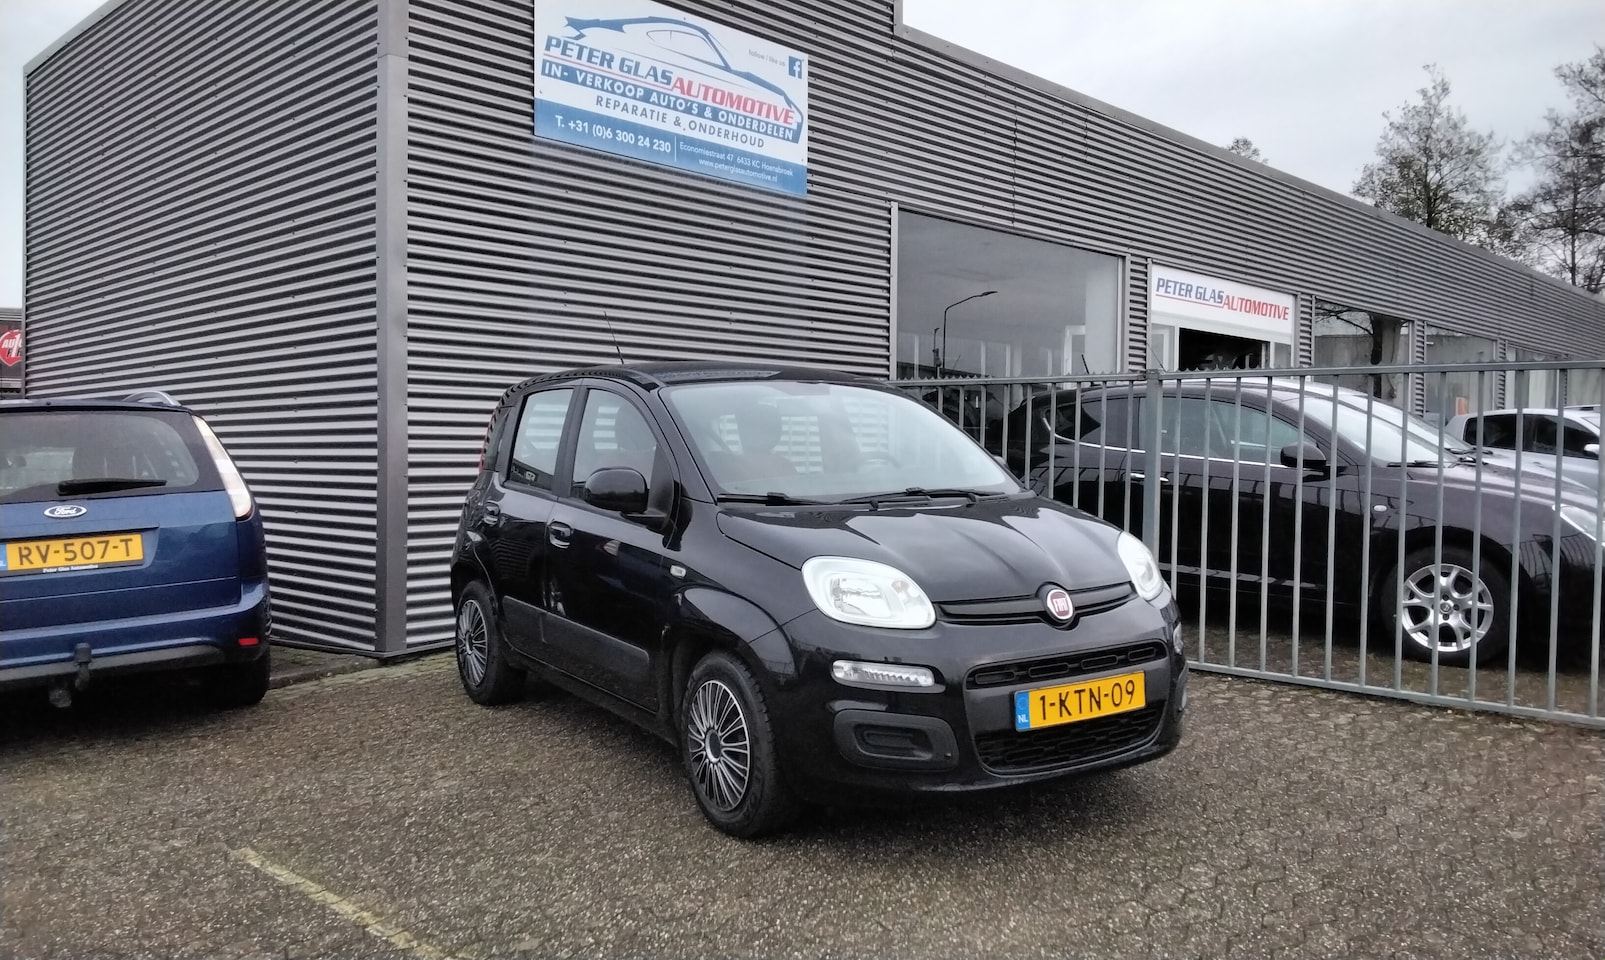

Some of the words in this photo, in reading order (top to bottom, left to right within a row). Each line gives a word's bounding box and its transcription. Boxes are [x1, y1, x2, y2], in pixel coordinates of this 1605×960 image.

[544, 35, 615, 70] PETER
[544, 62, 569, 78] IN-
[576, 70, 644, 99] VERKOOP
[649, 92, 699, 115] AUTO'S
[703, 106, 713, 119] &
[718, 111, 793, 140] ONDERDELEN
[555, 115, 565, 128] T.
[568, 120, 589, 134] +31
[592, 124, 613, 140] (0)6
[615, 129, 635, 144] 300
[637, 135, 651, 148] 24
[653, 138, 671, 153] 230
[595, 95, 668, 123] REPARATIE
[673, 115, 682, 128] &
[688, 120, 765, 148] ONDERHOUD
[679, 141, 726, 160] Economiestraat
[726, 153, 734, 161] 47
[736, 155, 752, 166] 6433
[752, 160, 761, 169] KC
[761, 163, 793, 177] Hoensbroek
[698, 158, 778, 182] www.peterglasautomotive.nl
[1156, 277, 1193, 299] PETER
[53, 506, 77, 516] Ford
[18, 538, 133, 566] RV-507-T
[1039, 679, 1136, 721] 1-KTN-09
[1017, 713, 1029, 724] NL
